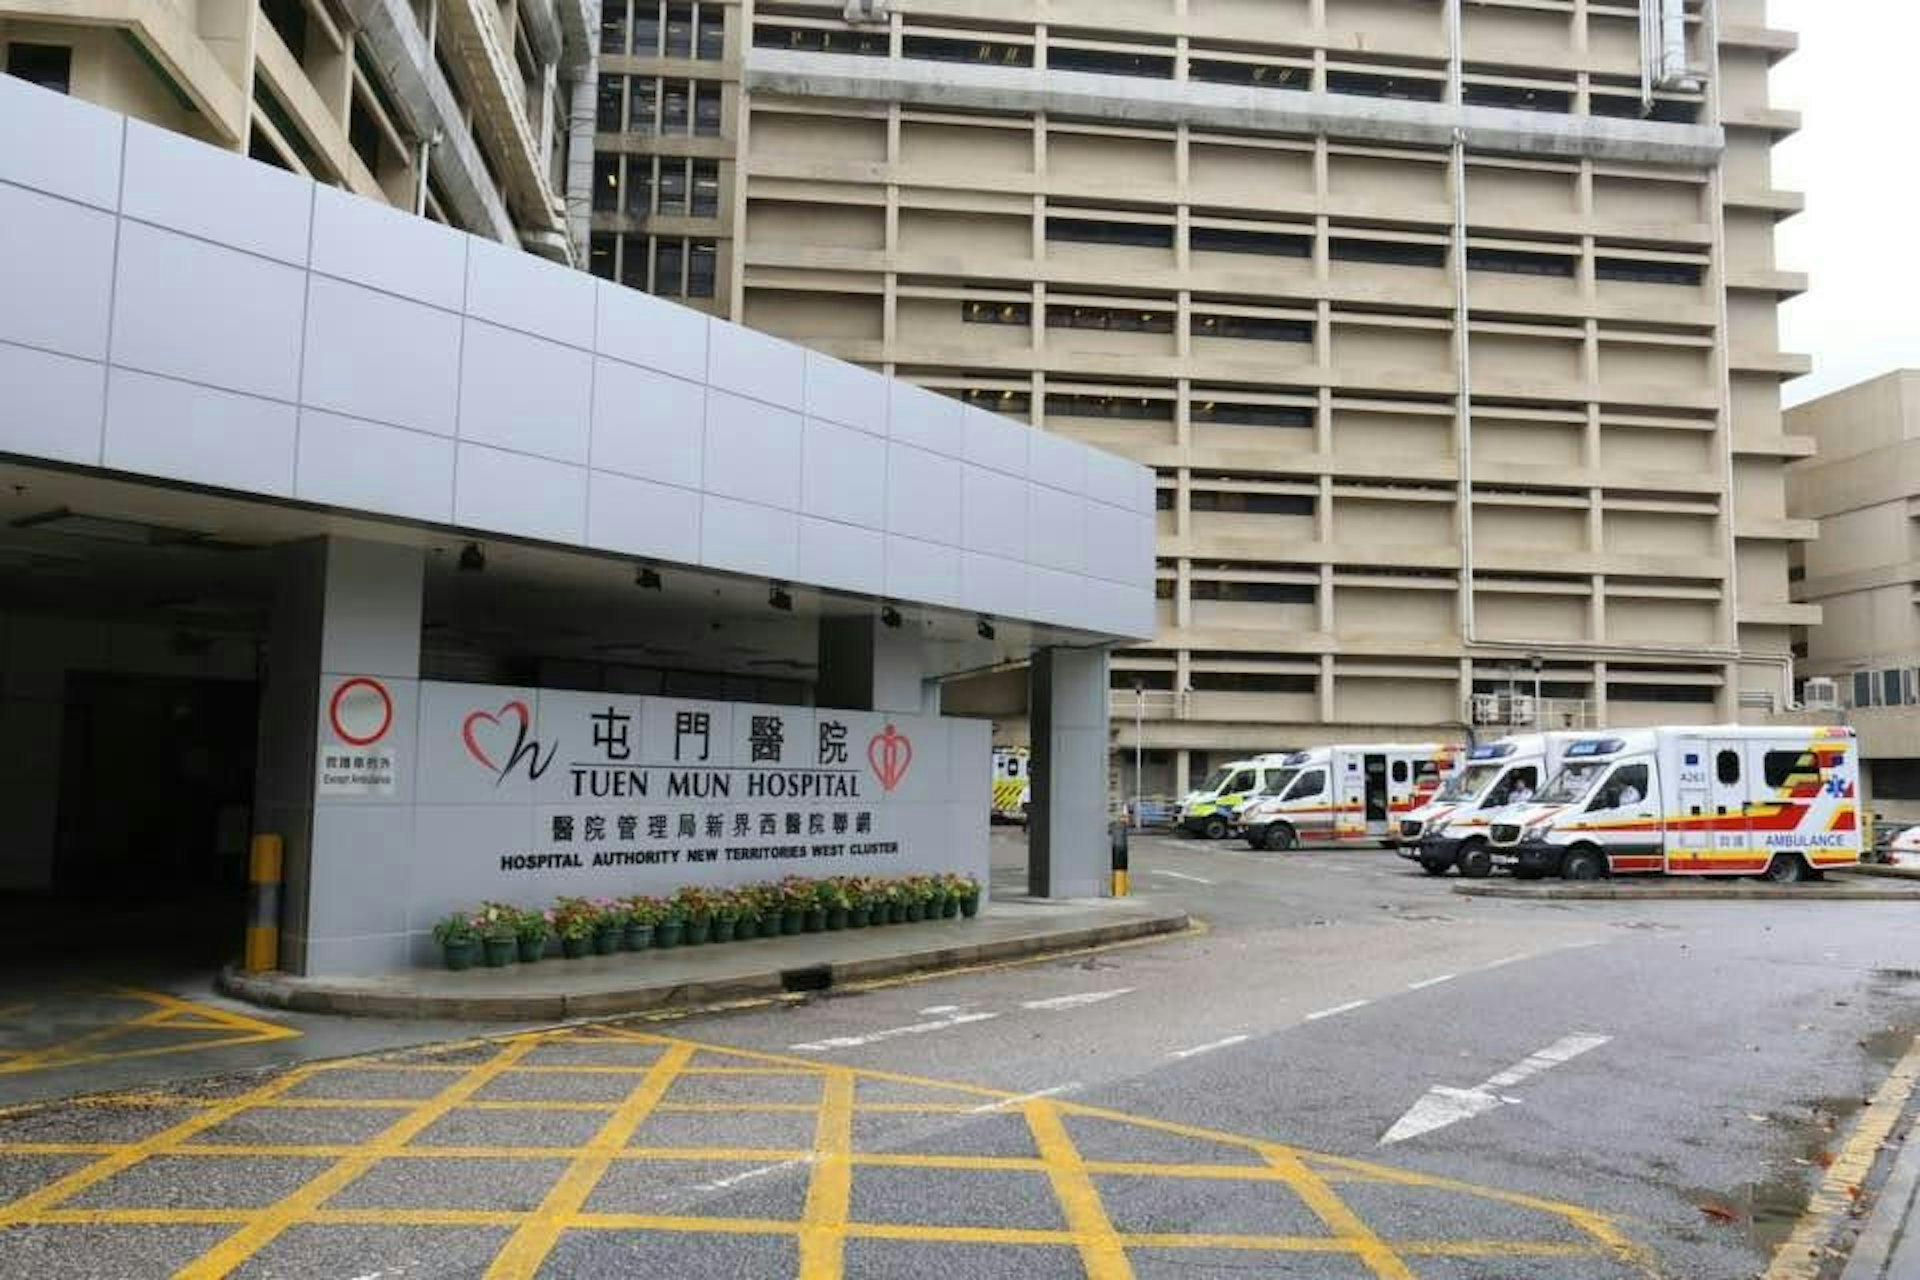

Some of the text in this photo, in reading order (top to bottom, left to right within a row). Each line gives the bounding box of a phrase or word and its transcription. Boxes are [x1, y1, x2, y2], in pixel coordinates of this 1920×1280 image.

[590, 706, 848, 764] 屯門醫院
[570, 770, 861, 797] TUEN MUN HOSPITAL
[552, 812, 871, 842] 醫院管理局新界西醫院聯網
[1766, 834, 1844, 846] AMBULANCE
[501, 841, 898, 870] HOSPITAL AUTHORITY NEW TERRITORIES WEST CLUSTER
